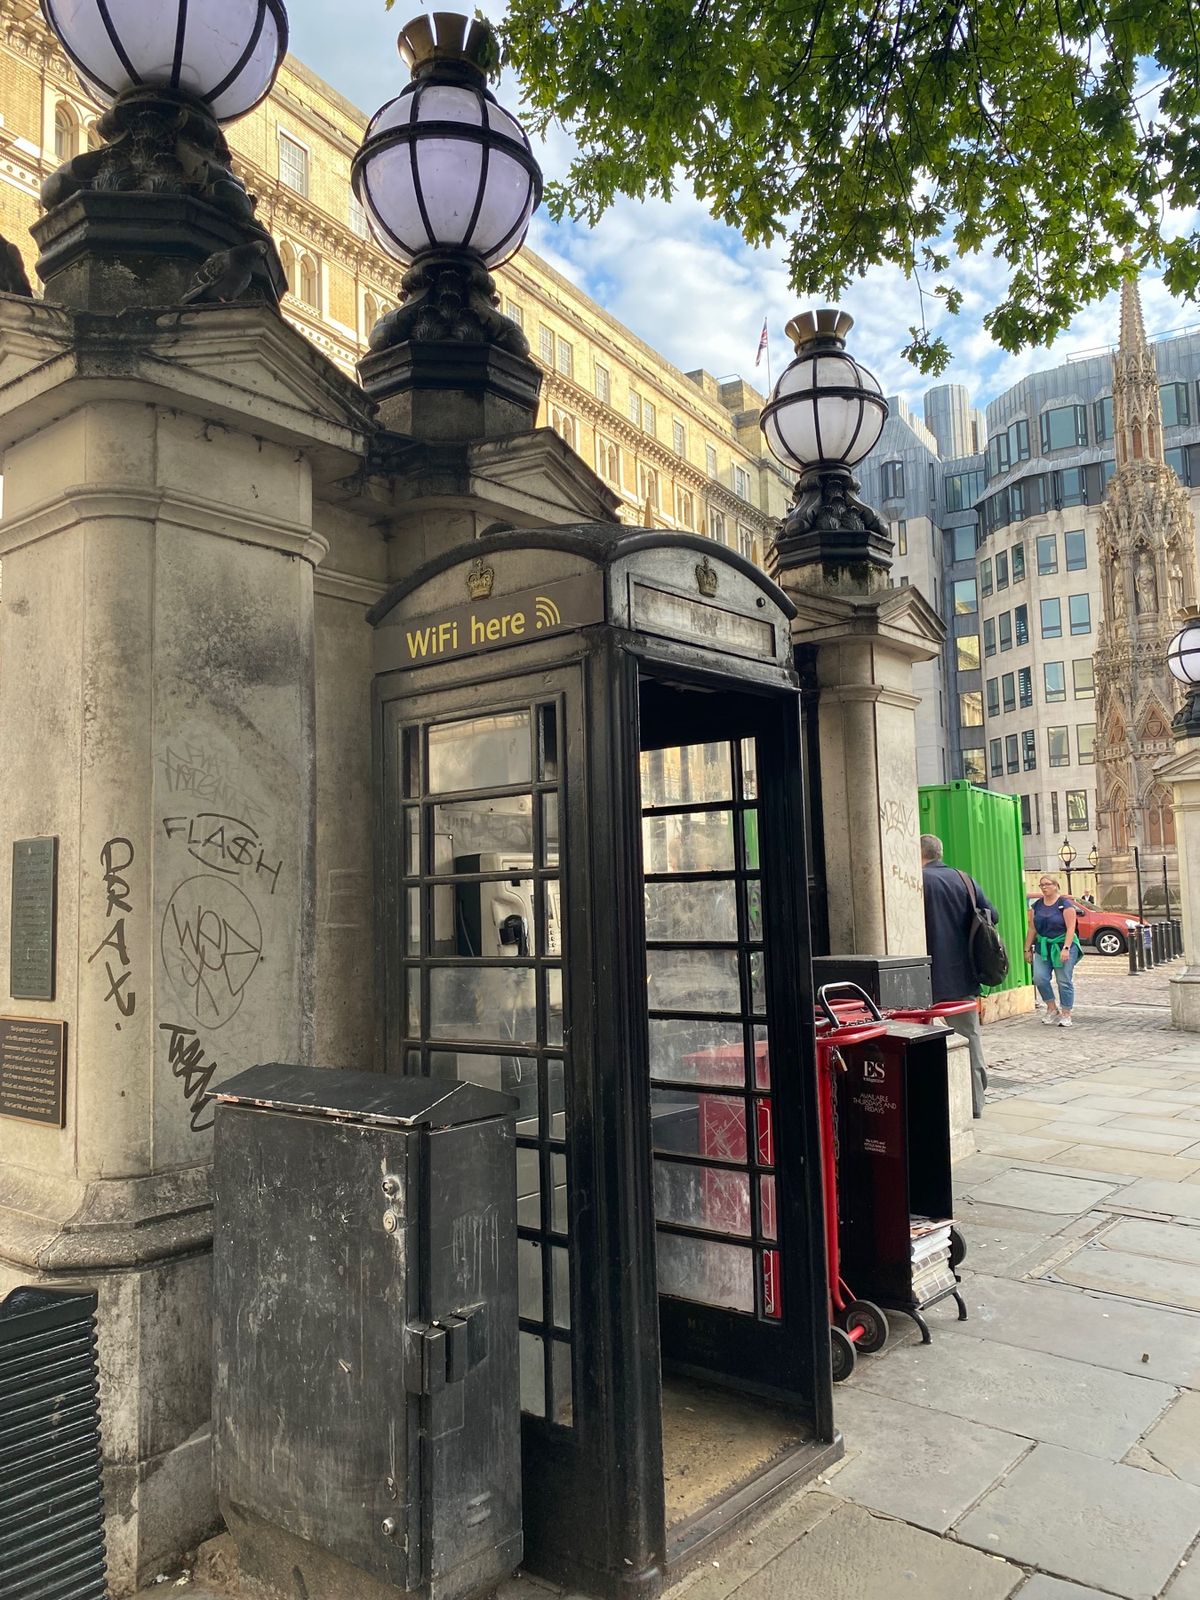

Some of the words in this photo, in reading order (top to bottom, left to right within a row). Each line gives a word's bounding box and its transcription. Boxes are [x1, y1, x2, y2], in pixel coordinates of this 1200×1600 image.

[406, 621, 458, 659] WiFi
[471, 611, 525, 645] here
[162, 815, 283, 895] FLASH
[864, 1061, 885, 1078] ES
[853, 1097, 882, 1108] THURSDAYS
[883, 1102, 896, 1110] AND
[860, 1093, 888, 1102] AVAILABLE
[864, 1105, 885, 1115] FRIDAYS
